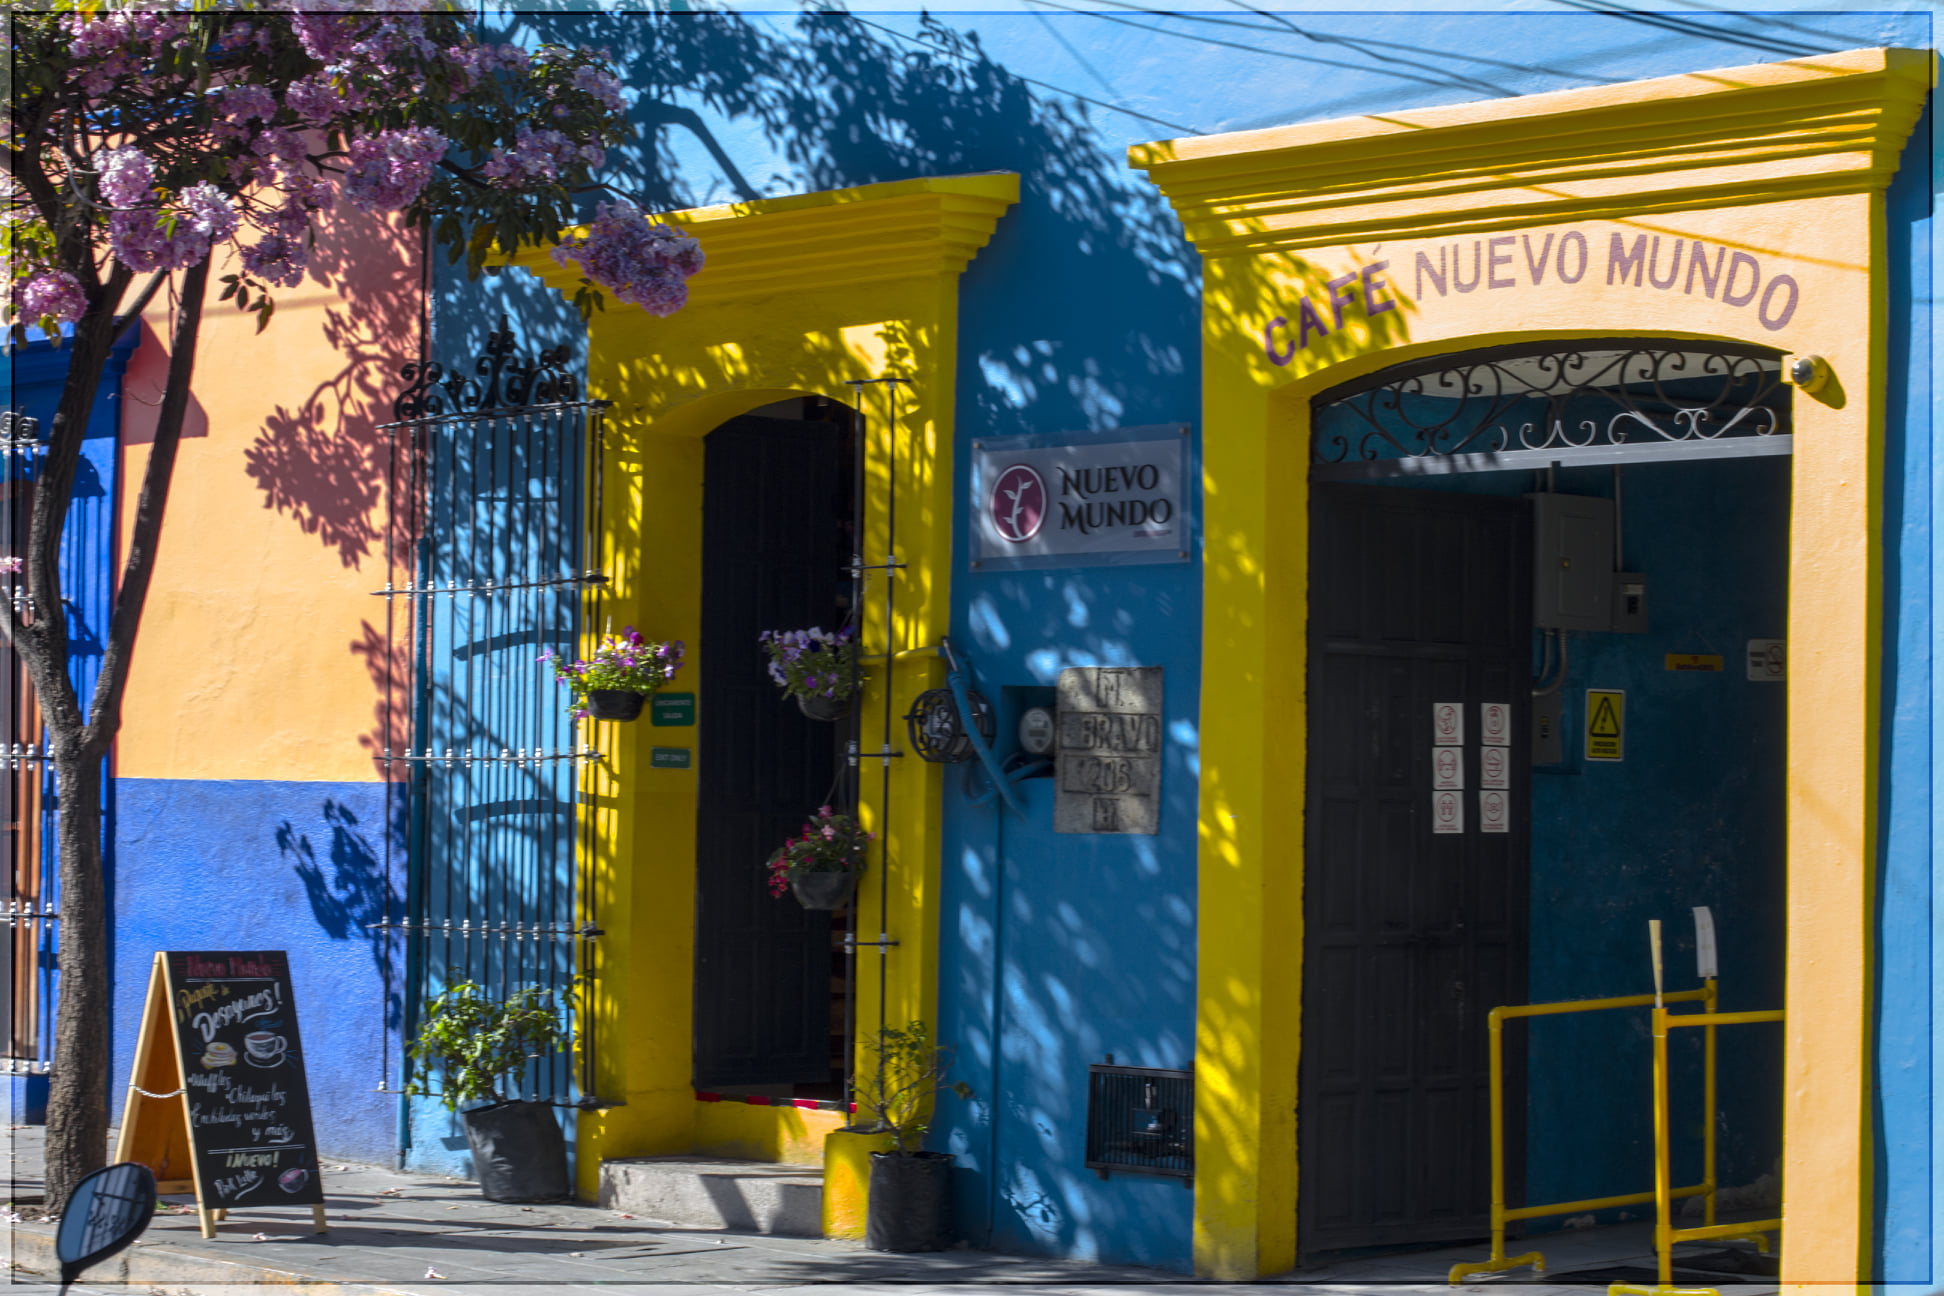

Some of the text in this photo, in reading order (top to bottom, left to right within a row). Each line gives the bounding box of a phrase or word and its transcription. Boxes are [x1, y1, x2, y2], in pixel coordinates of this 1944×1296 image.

[1264, 231, 1799, 367] CAFÉ NUEVO MUNDO
[1056, 464, 1159, 499] NUEVO
[1058, 498, 1173, 535] MUNDO
[1082, 714, 1160, 752] BRAVO
